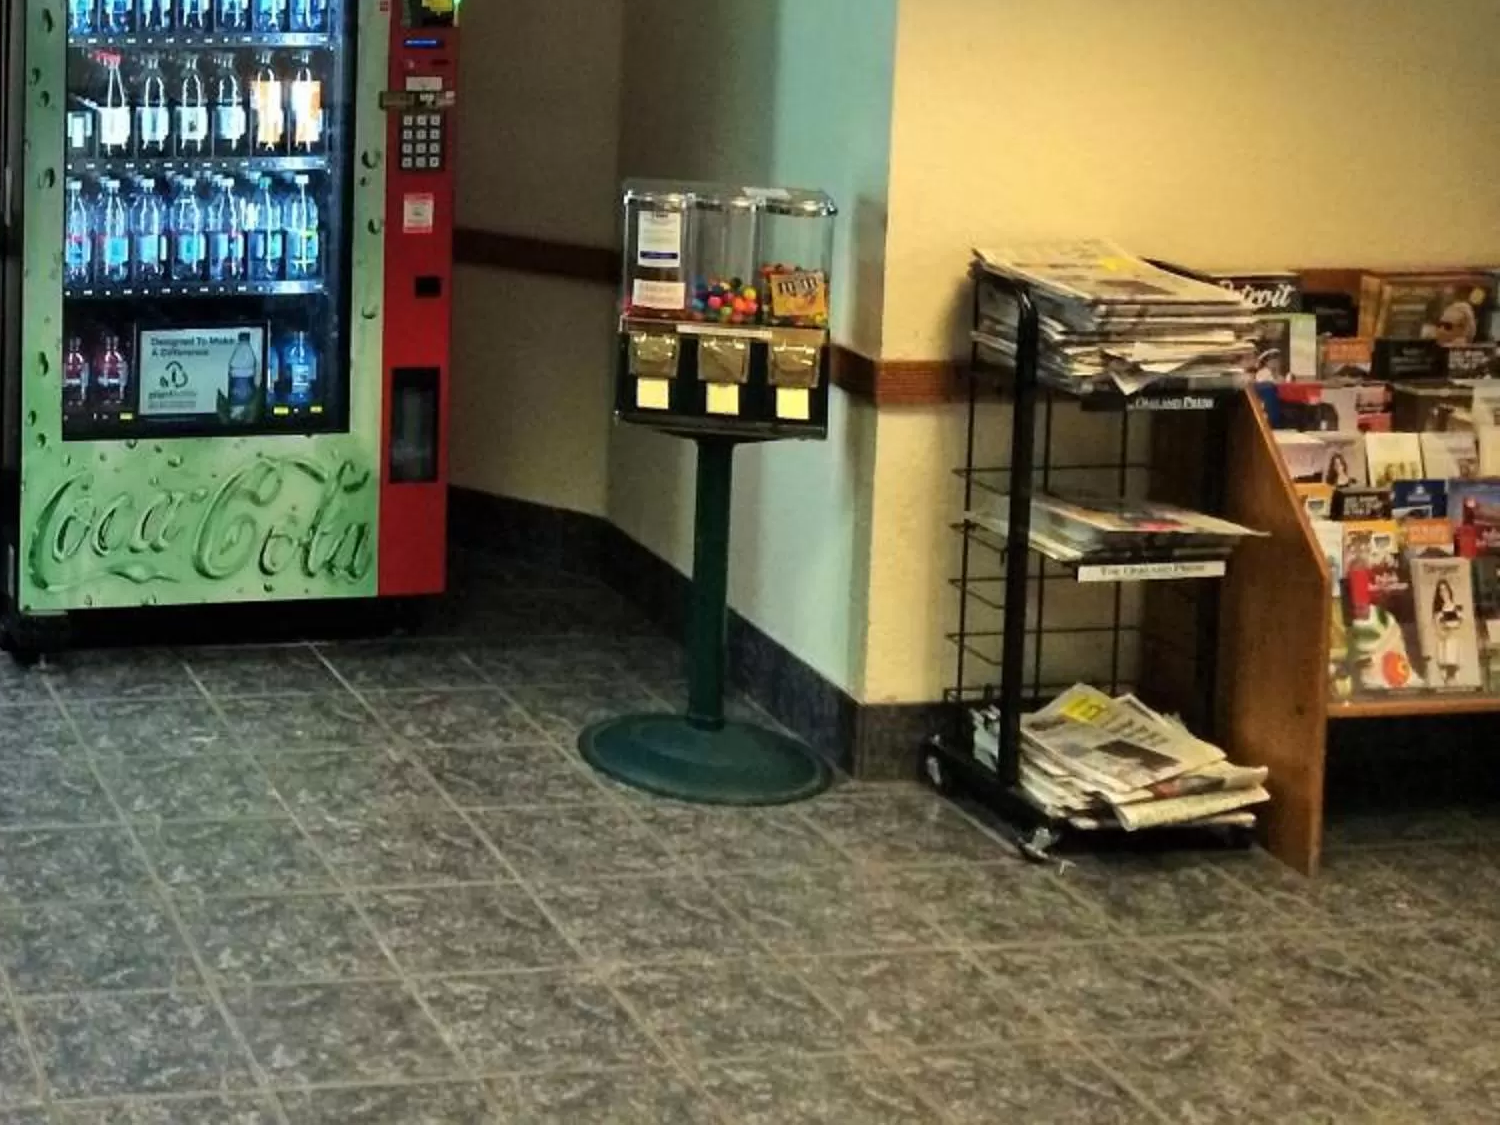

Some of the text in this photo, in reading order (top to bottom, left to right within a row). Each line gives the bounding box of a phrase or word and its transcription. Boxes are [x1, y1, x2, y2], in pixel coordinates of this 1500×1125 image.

[1219, 279, 1297, 308] troit
[196, 337, 209, 346] To
[28, 451, 373, 592] Coca-Cola
